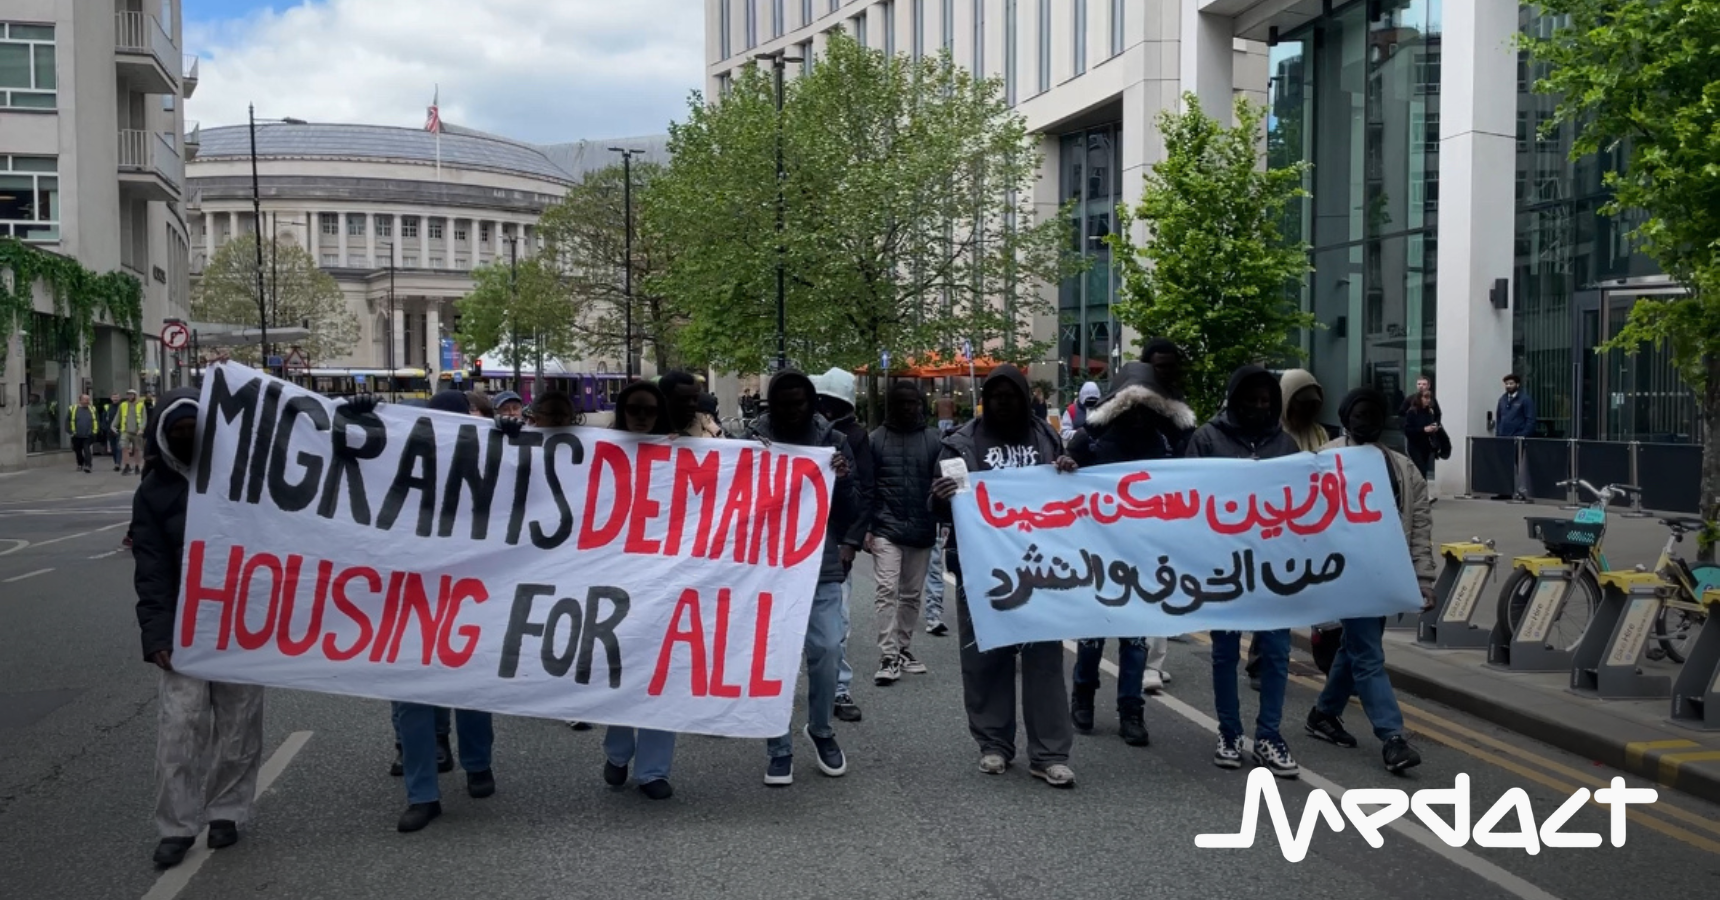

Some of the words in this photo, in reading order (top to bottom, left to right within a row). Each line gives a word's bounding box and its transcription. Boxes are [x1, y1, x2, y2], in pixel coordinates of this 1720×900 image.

[195, 366, 584, 550] MIGRANTS
[578, 441, 830, 568] DEMAND
[1089, 472, 1200, 525] سكن
[180, 540, 489, 669] HOUSING
[498, 583, 631, 690] FOR
[648, 588, 783, 698] ALL
